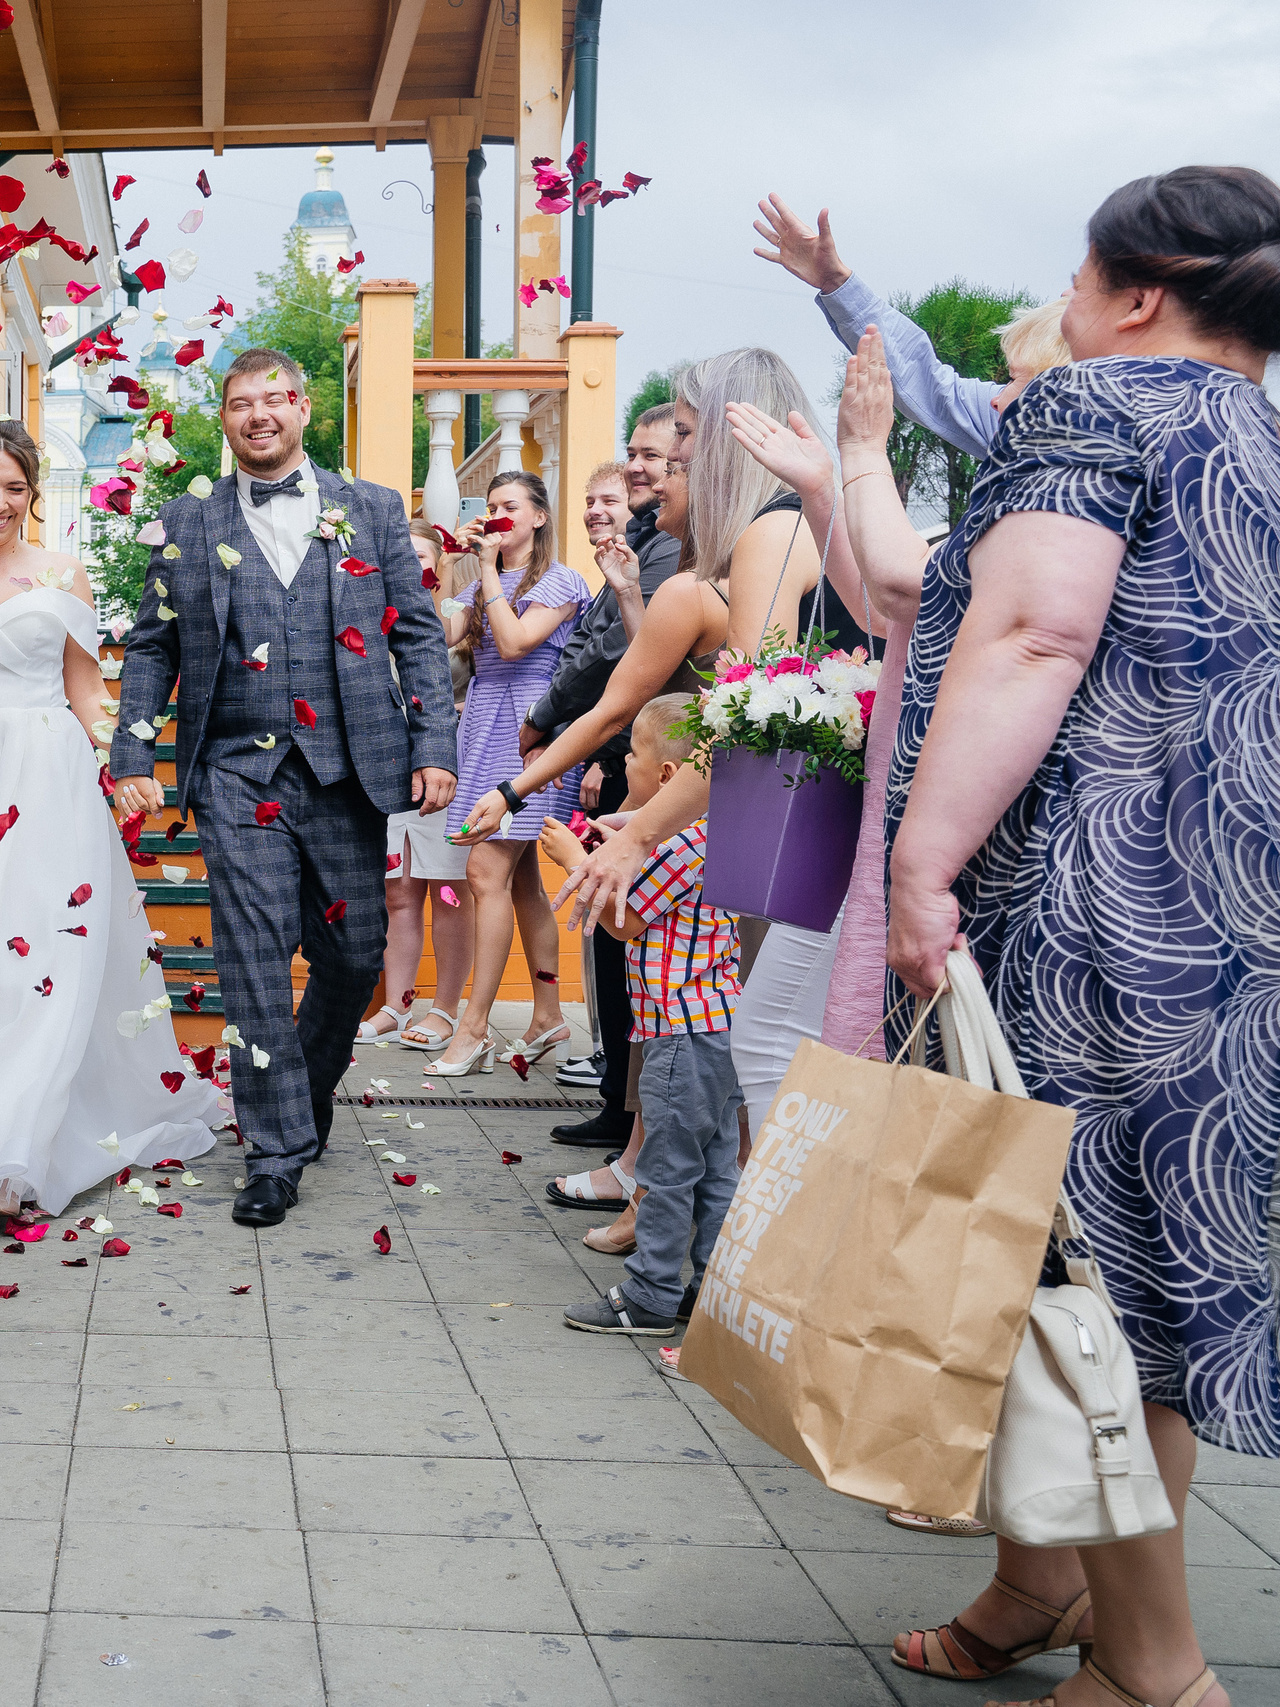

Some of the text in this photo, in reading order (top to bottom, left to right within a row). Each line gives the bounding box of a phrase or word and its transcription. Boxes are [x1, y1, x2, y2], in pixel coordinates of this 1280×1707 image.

[774, 1091, 849, 1143] ONLY
[755, 1123, 816, 1177] THE
[735, 1159, 804, 1216] BEST
[709, 1234, 754, 1290] THE
[698, 1273, 794, 1365] ATHLETE
